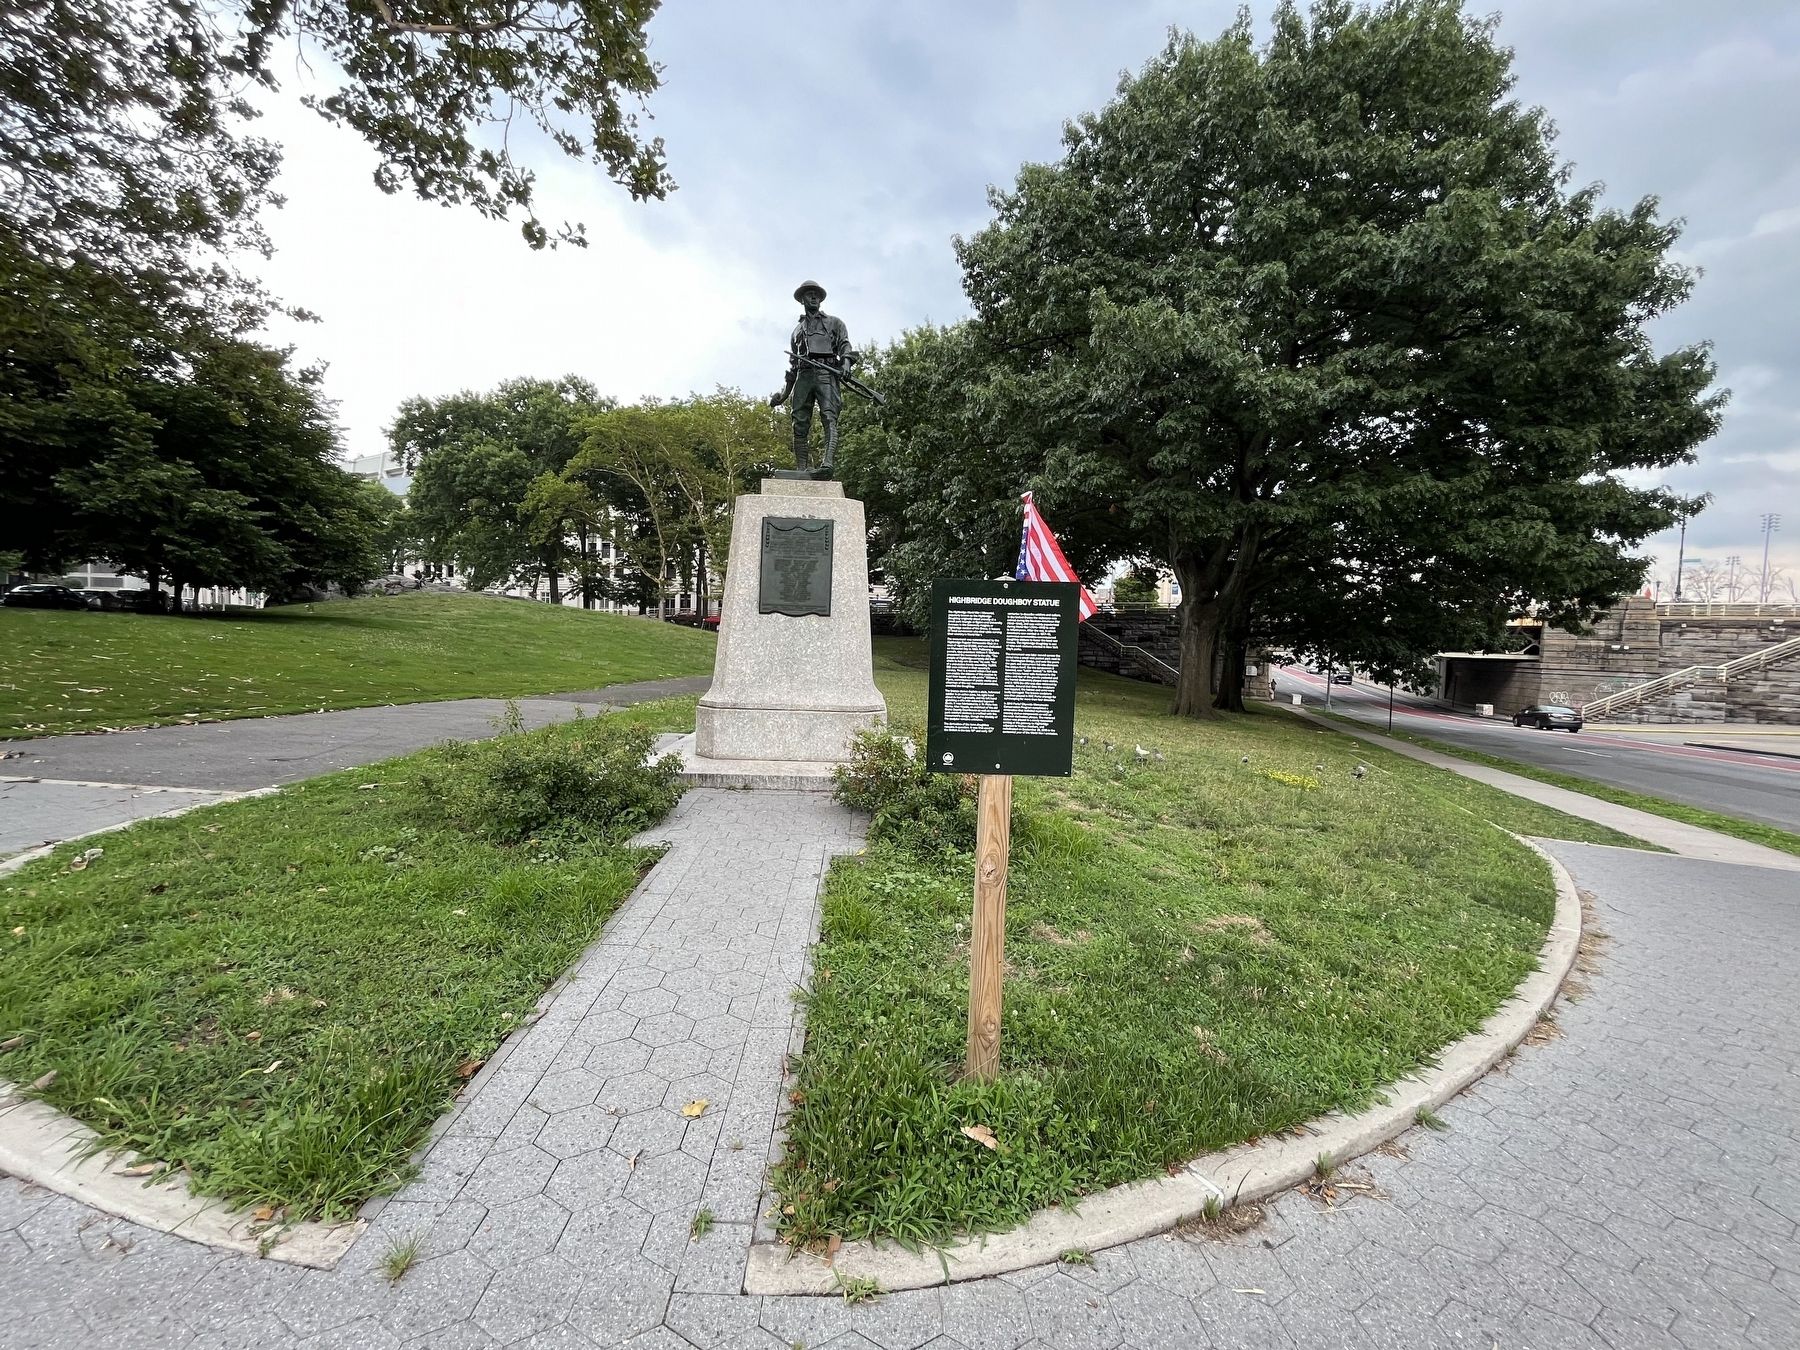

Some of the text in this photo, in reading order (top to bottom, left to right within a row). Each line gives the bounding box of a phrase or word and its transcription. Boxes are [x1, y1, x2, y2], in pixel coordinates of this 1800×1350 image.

[948, 596, 1060, 607] HIGHBRIDGE DOUGHBOY STATUE
